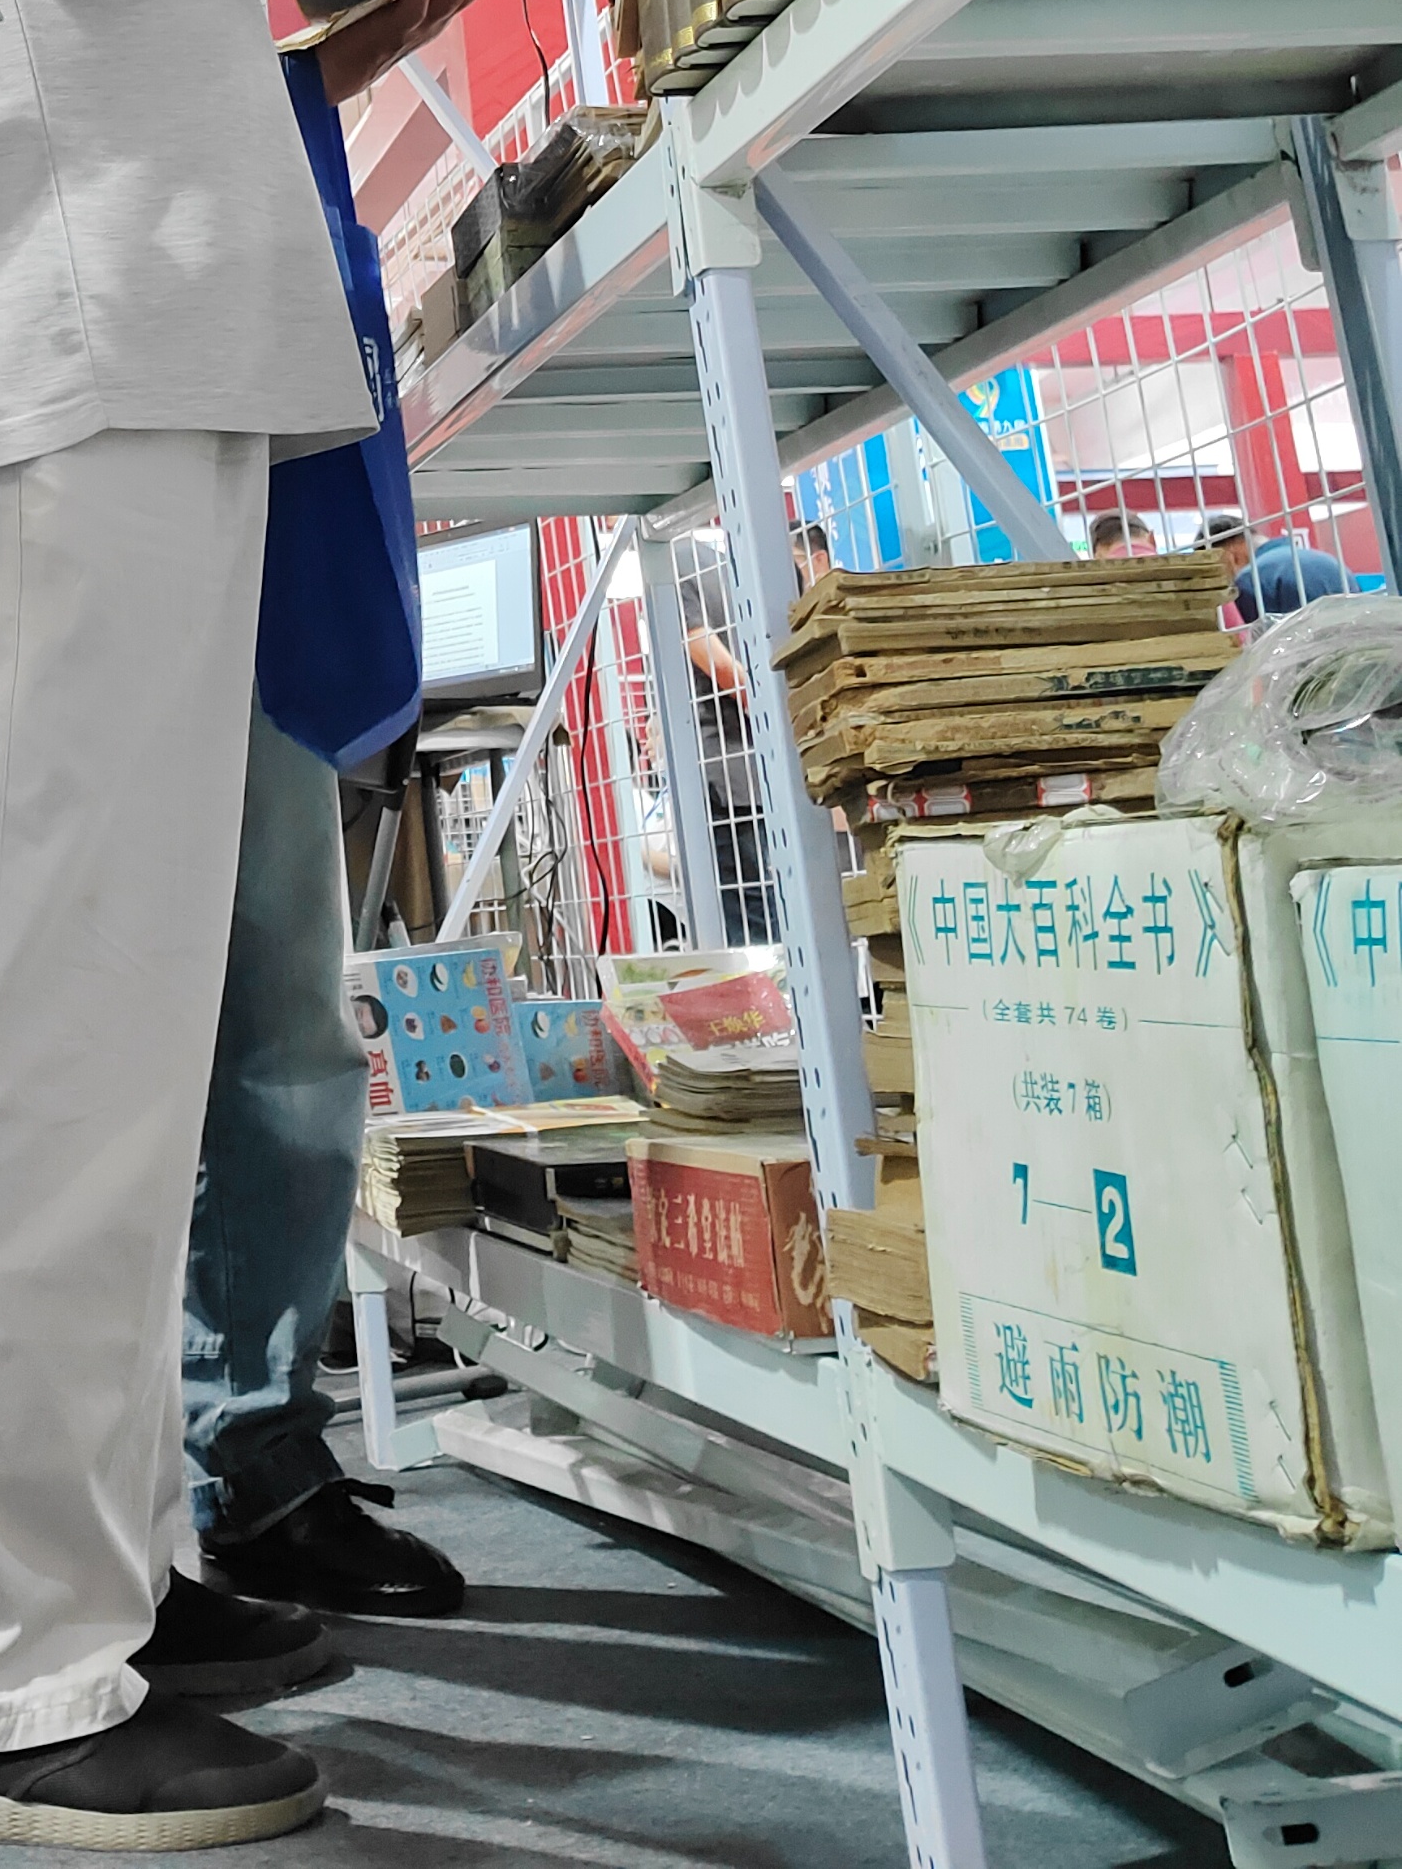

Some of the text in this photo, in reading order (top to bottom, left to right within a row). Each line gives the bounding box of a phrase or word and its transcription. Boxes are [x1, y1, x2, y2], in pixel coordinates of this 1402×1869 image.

[1312, 873, 1402, 989] 《中
[992, 1320, 1212, 1464] 避雨防潮
